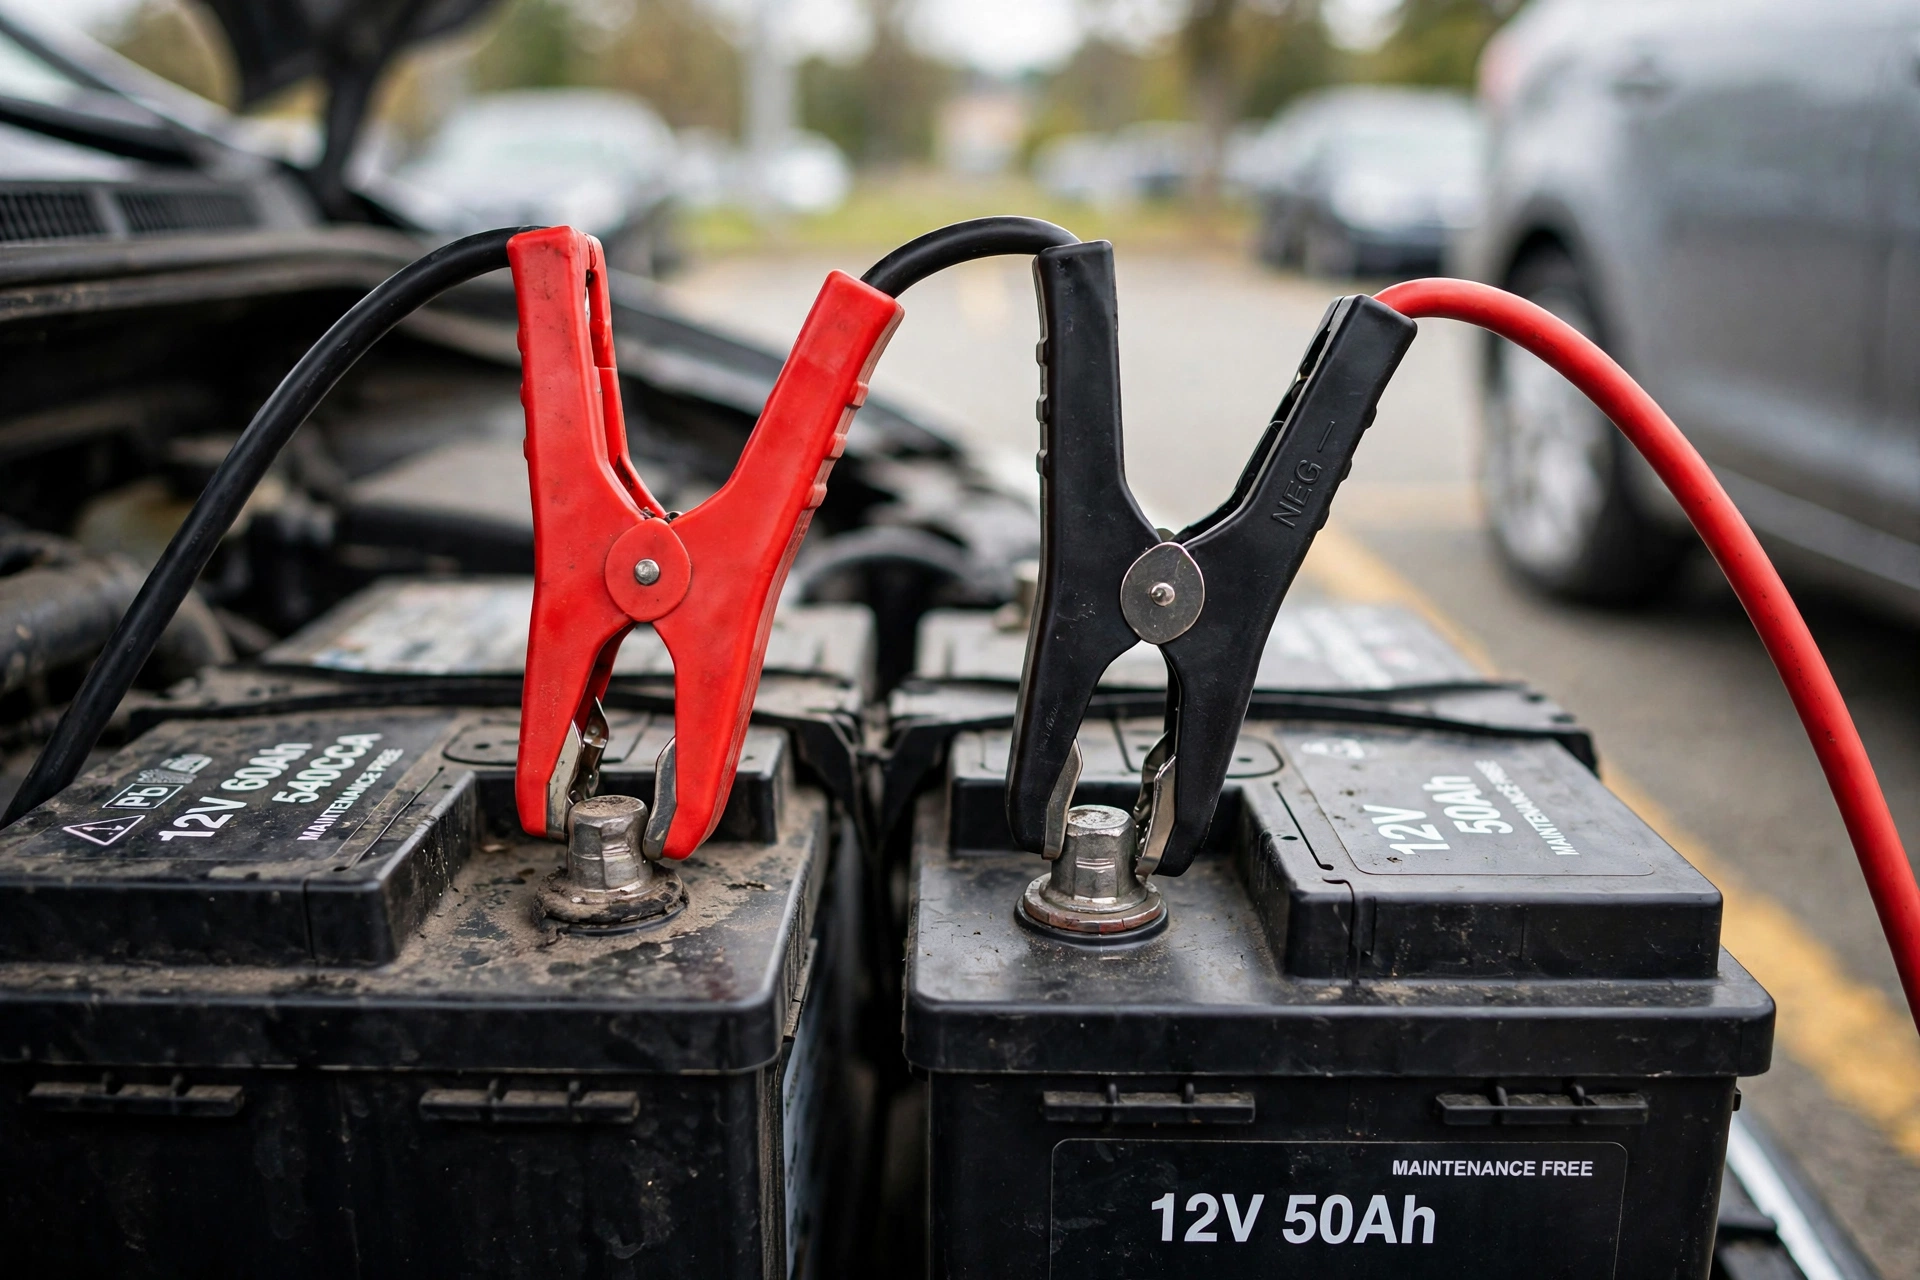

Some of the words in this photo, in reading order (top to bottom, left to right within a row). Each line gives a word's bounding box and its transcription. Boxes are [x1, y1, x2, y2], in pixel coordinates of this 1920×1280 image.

[1271, 459, 1323, 530] NEG
[158, 796, 248, 841] 12V
[220, 743, 313, 791] 60Ah
[271, 733, 384, 804] 540CCA
[114, 786, 169, 807] Pb
[1422, 776, 1514, 834] 50Ah
[1363, 804, 1451, 855] 12V
[1392, 1160, 1536, 1176] MAINTENANCE
[1541, 1161, 1594, 1177] FREE
[1151, 1192, 1265, 1242] 12V
[1282, 1194, 1436, 1244] 50Ah
